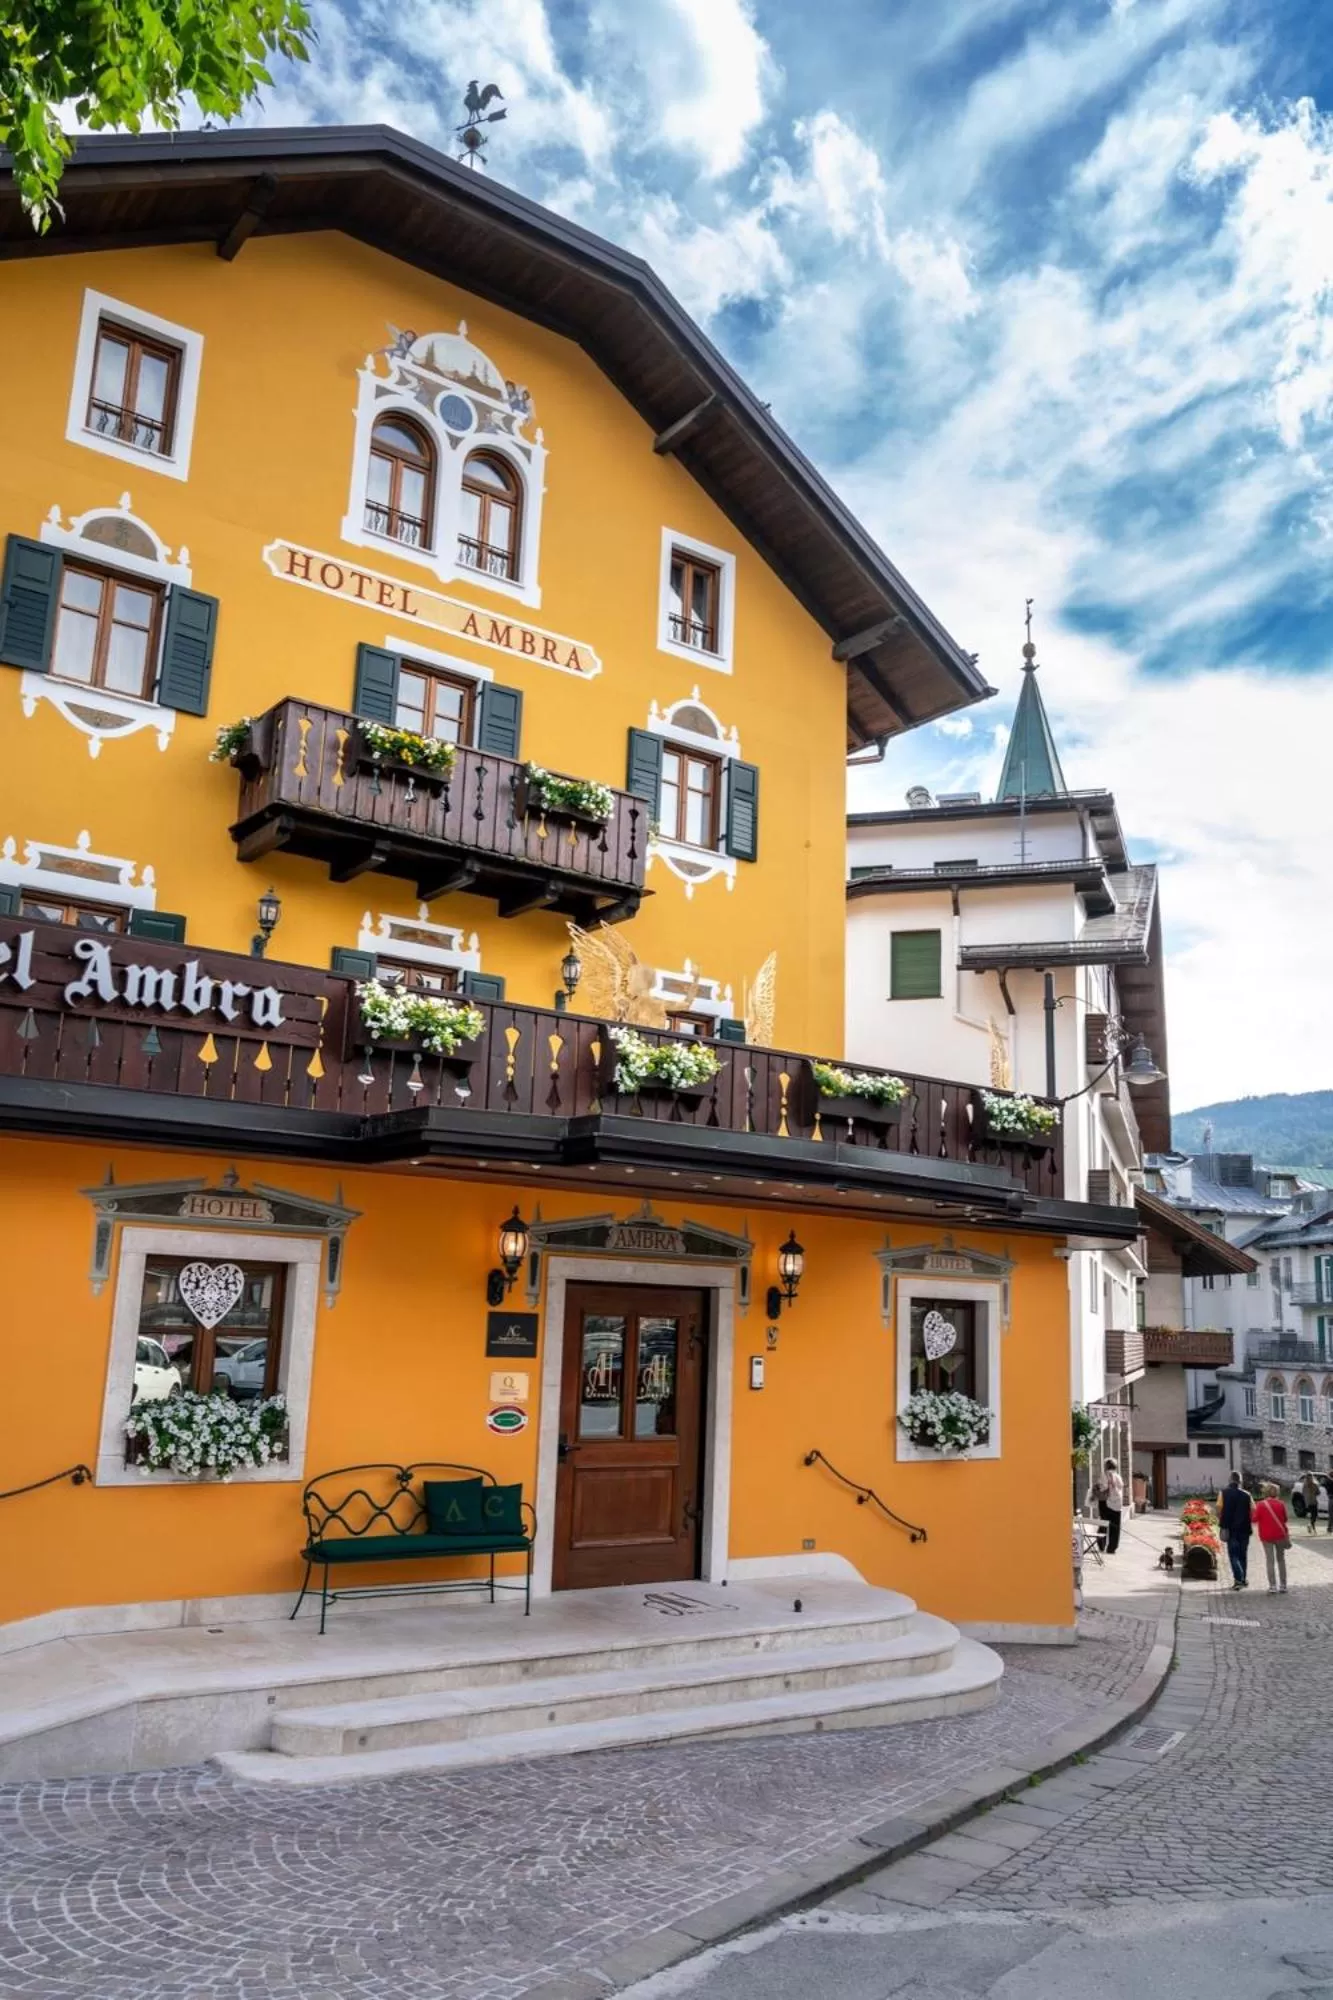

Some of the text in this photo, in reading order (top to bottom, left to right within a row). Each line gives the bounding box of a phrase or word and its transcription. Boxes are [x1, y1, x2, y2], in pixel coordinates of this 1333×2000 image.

[285, 549, 583, 672] HOTEL AMBRA
[64, 939, 286, 1027] Ambra
[190, 1197, 262, 1218] HOTEL
[614, 1229, 678, 1252] AMBRA
[1092, 1407, 1128, 1419] TEST
